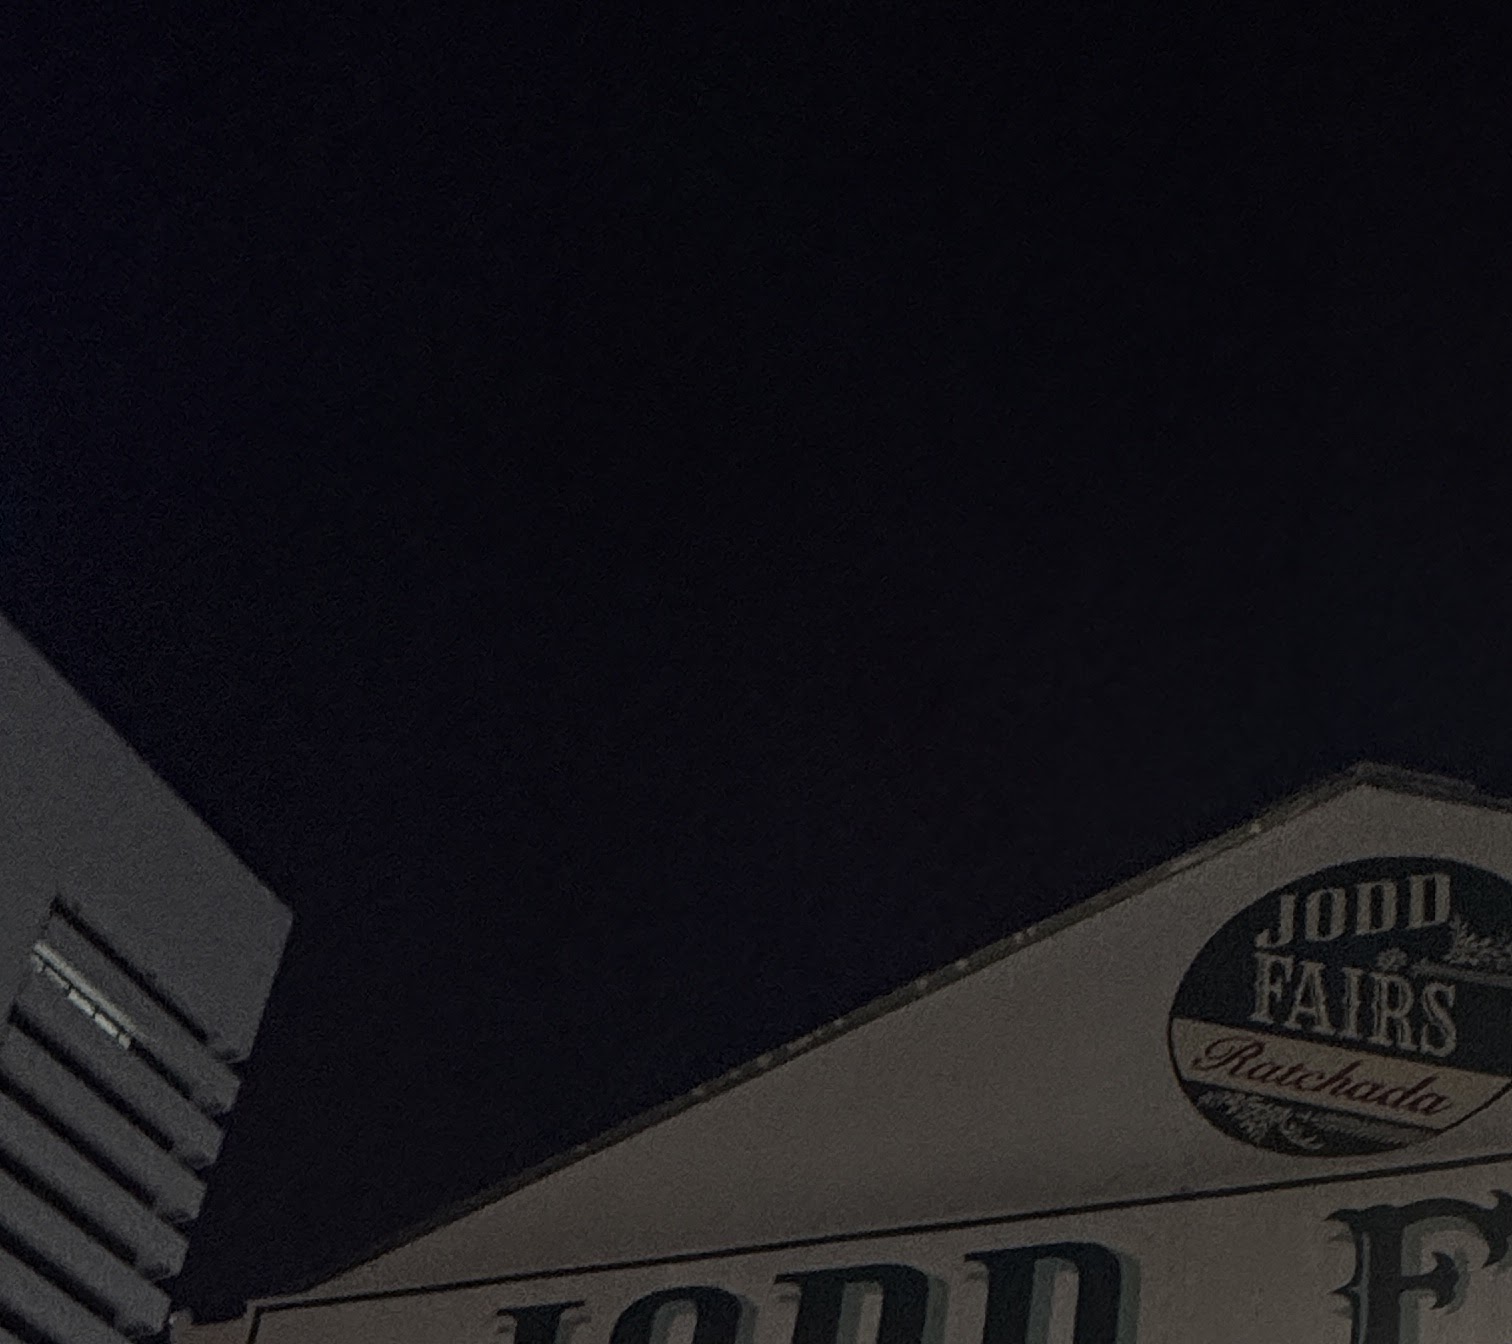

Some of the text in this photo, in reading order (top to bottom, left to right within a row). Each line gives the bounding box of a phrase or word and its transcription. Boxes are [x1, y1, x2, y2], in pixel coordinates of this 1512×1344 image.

[1255, 872, 1453, 948] JODD
[1249, 950, 1459, 1058] FAIRS
[1191, 1036, 1454, 1117] Ratchada
